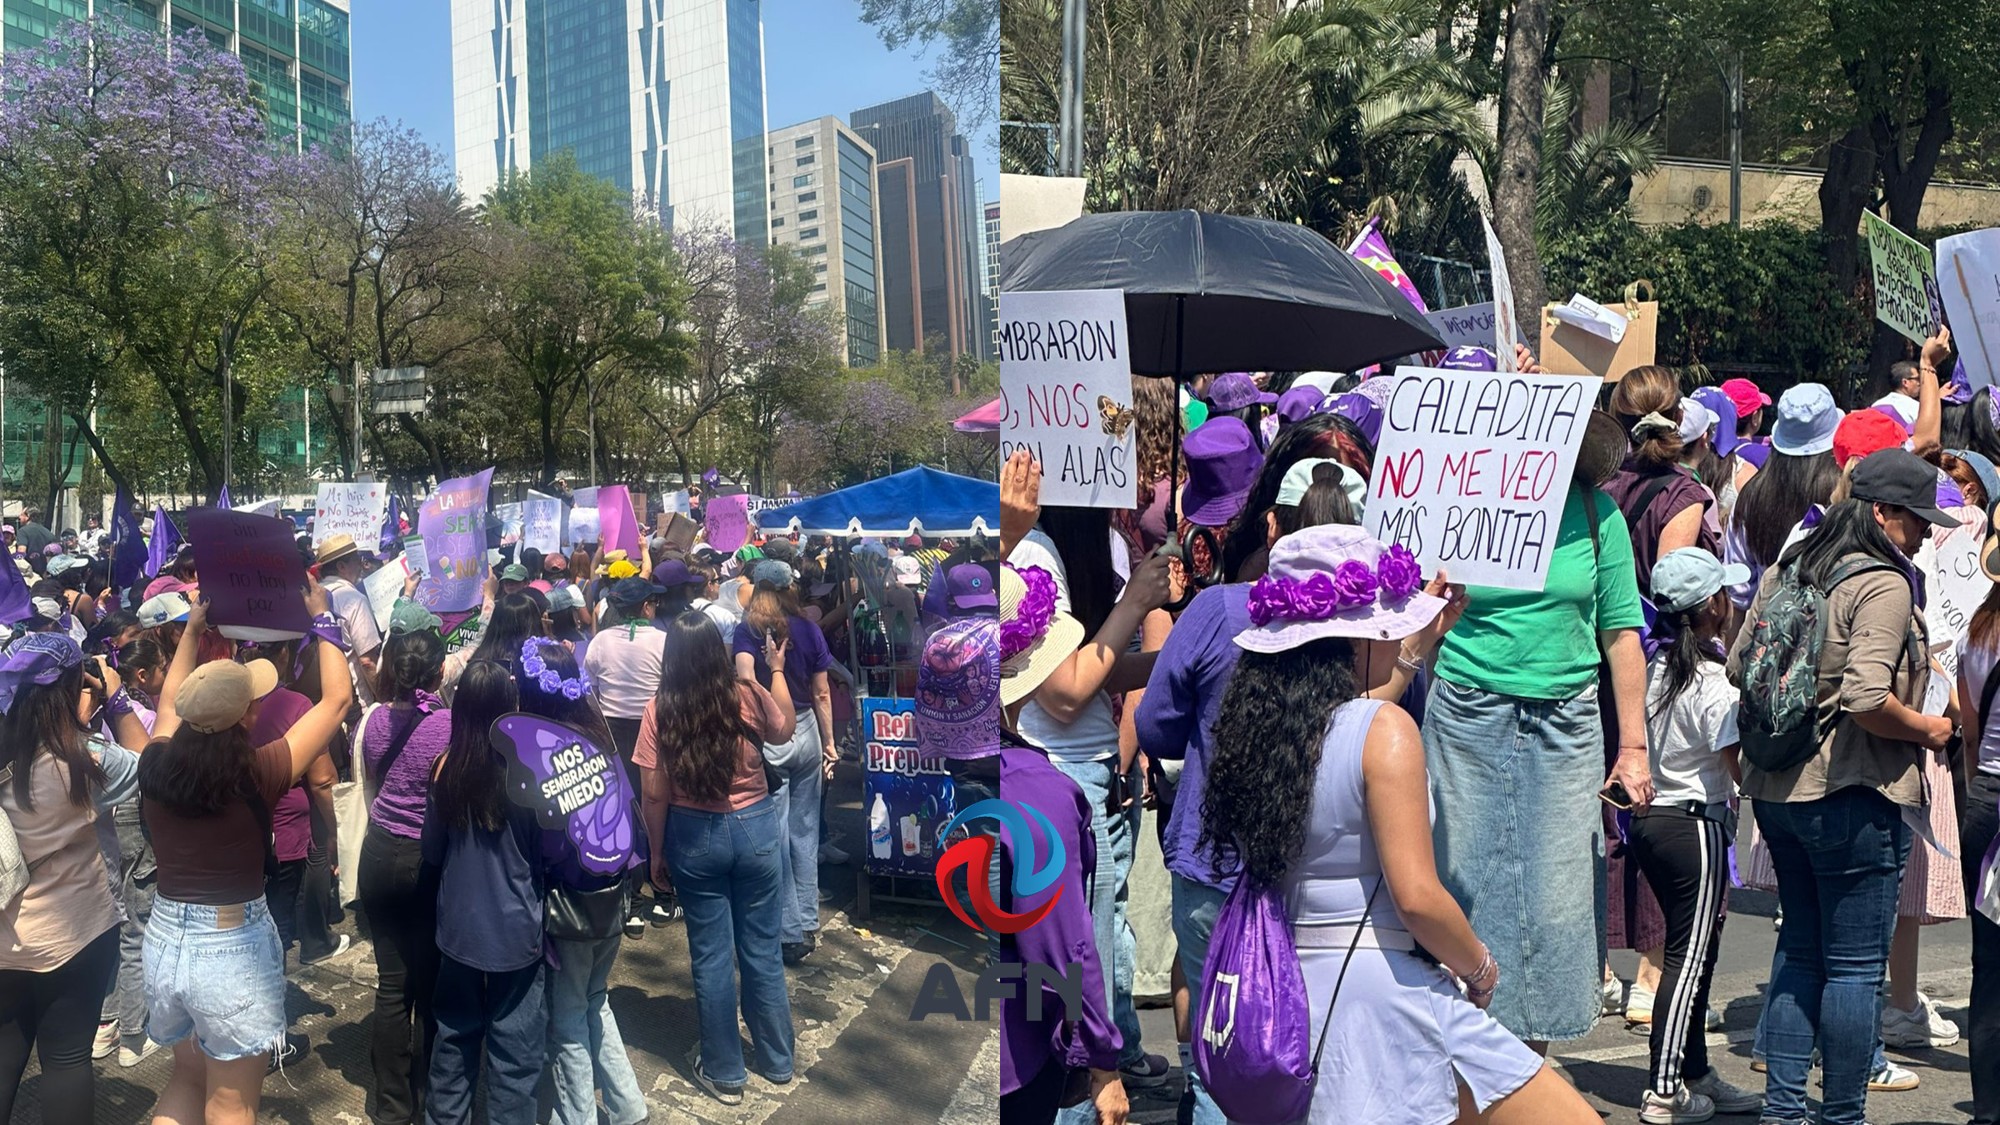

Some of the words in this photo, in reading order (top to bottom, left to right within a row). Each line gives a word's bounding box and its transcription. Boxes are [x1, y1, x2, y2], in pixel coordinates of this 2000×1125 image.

[1026, 383, 1090, 429] NOS
[1389, 376, 1583, 445] CALLADITA
[1060, 444, 1127, 489] ALAS
[1378, 448, 1424, 499] NO
[1437, 448, 1492, 496] ME
[1500, 450, 1558, 502] VEO
[439, 494, 454, 511] LA
[1378, 501, 1428, 560] MÁS
[1438, 505, 1547, 574] BONITA
[541, 754, 608, 799] SEMBRARON
[552, 744, 585, 774] NOS
[557, 775, 605, 816] MIEDO
